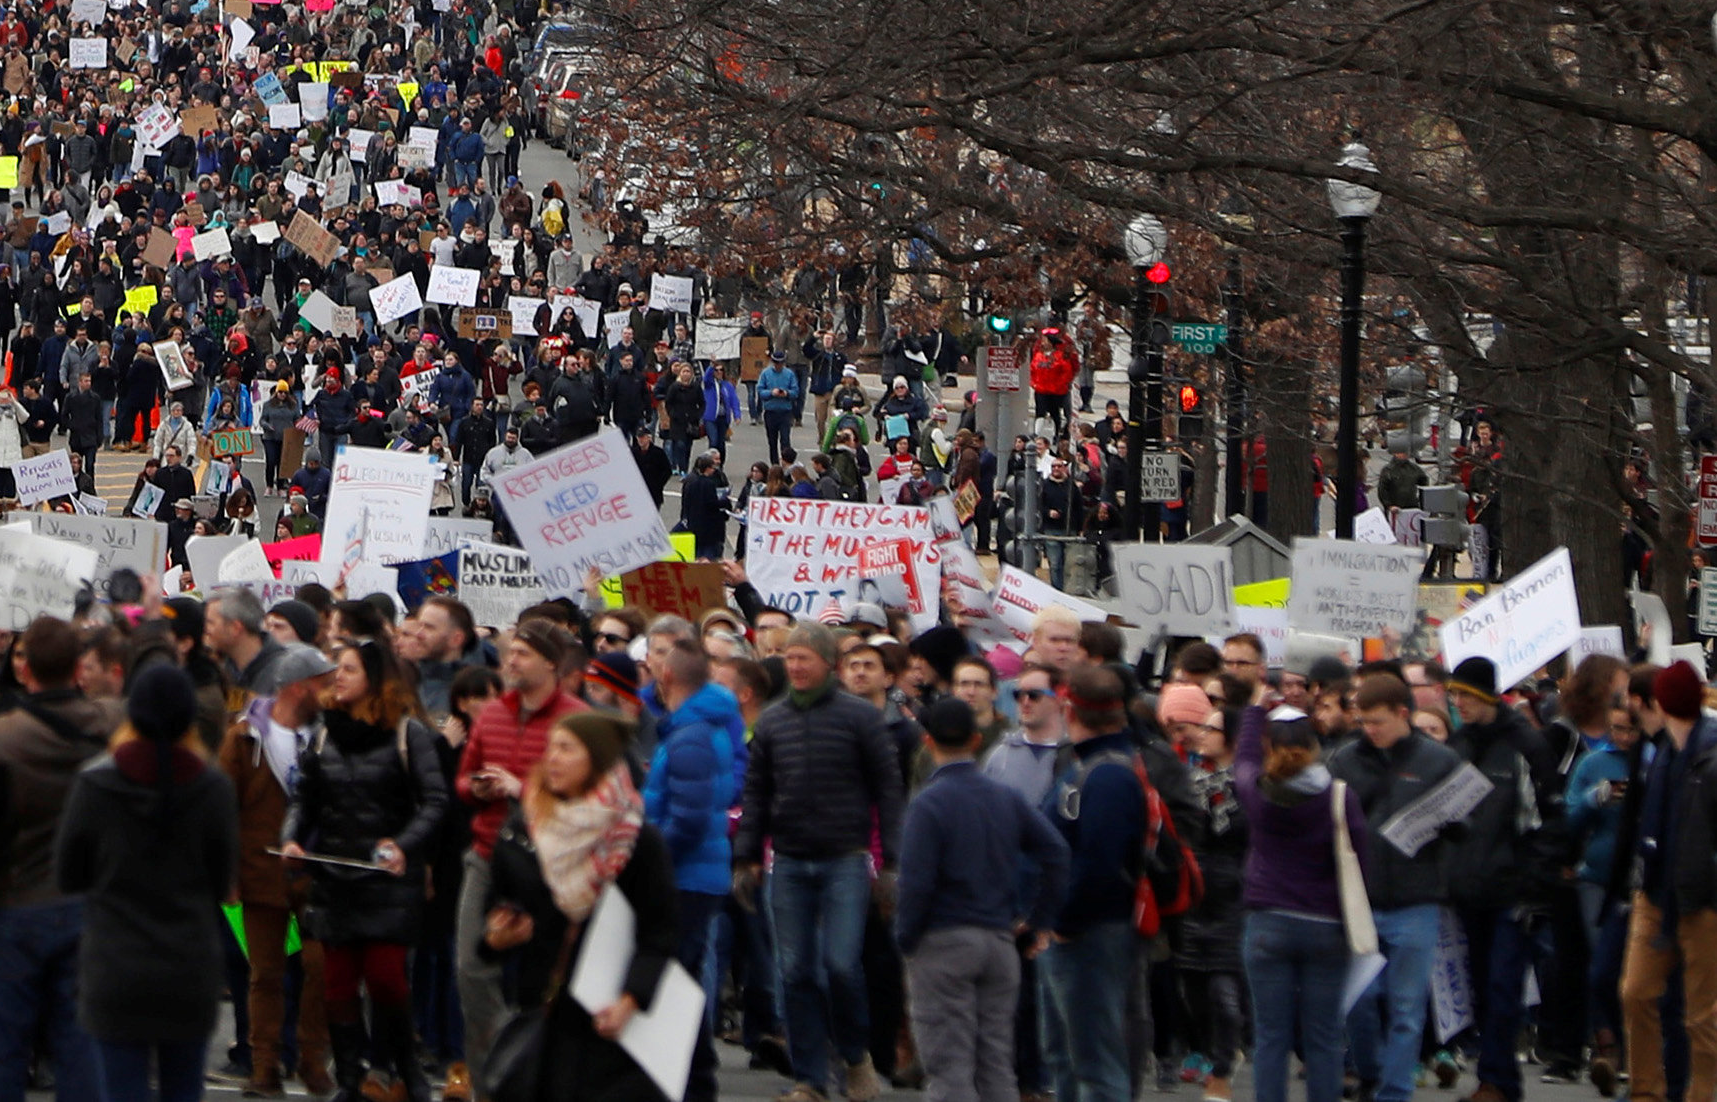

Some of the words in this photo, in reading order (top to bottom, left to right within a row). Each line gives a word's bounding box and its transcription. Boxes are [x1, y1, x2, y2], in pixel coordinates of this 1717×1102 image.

[1172, 325, 1216, 341] FIRST
[1186, 343, 1215, 353] 100
[215, 436, 248, 454] ON
[503, 441, 611, 501] REFUGEES
[1146, 456, 1163, 466] NO
[1153, 478, 1176, 488] RED
[545, 481, 599, 516] NEED
[540, 495, 633, 548] REFUGE
[751, 498, 813, 525] FIRST
[768, 530, 816, 558] THE
[821, 532, 942, 565] MUSMS
[463, 552, 530, 574] MUSLIM
[639, 560, 688, 585] LET
[793, 562, 815, 583] &
[1321, 549, 1412, 573] IMMIGRATION
[462, 573, 497, 587] CARD
[542, 565, 571, 594] NO
[1004, 572, 1023, 588] no
[626, 581, 702, 607] THEM
[768, 590, 820, 616] NOT
[1000, 587, 1039, 612] huma
[1459, 612, 1495, 644] Ban
